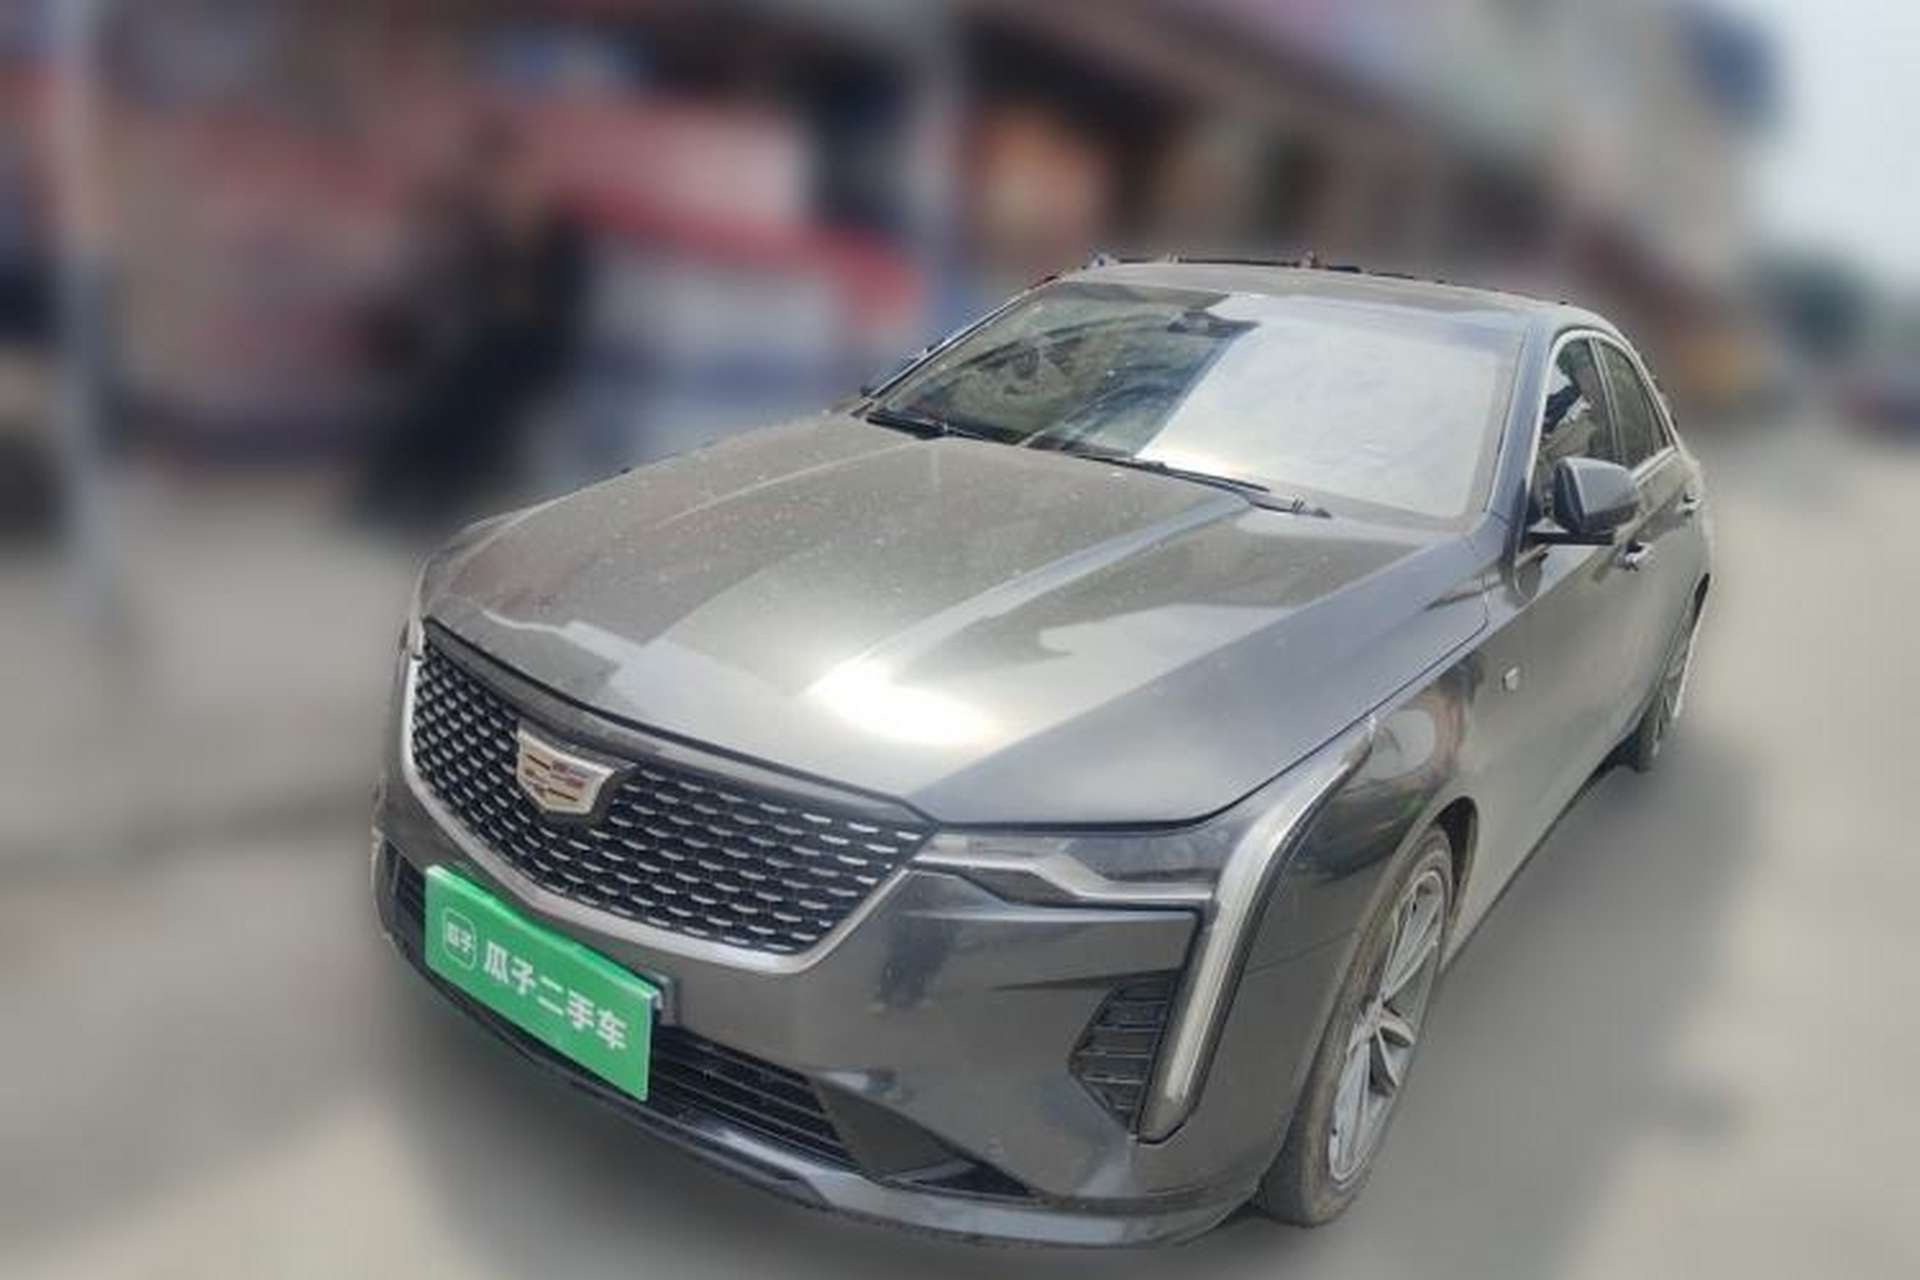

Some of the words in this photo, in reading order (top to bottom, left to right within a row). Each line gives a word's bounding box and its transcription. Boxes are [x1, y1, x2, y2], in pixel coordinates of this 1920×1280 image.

[484, 940, 627, 1050] 瓜子二手车
